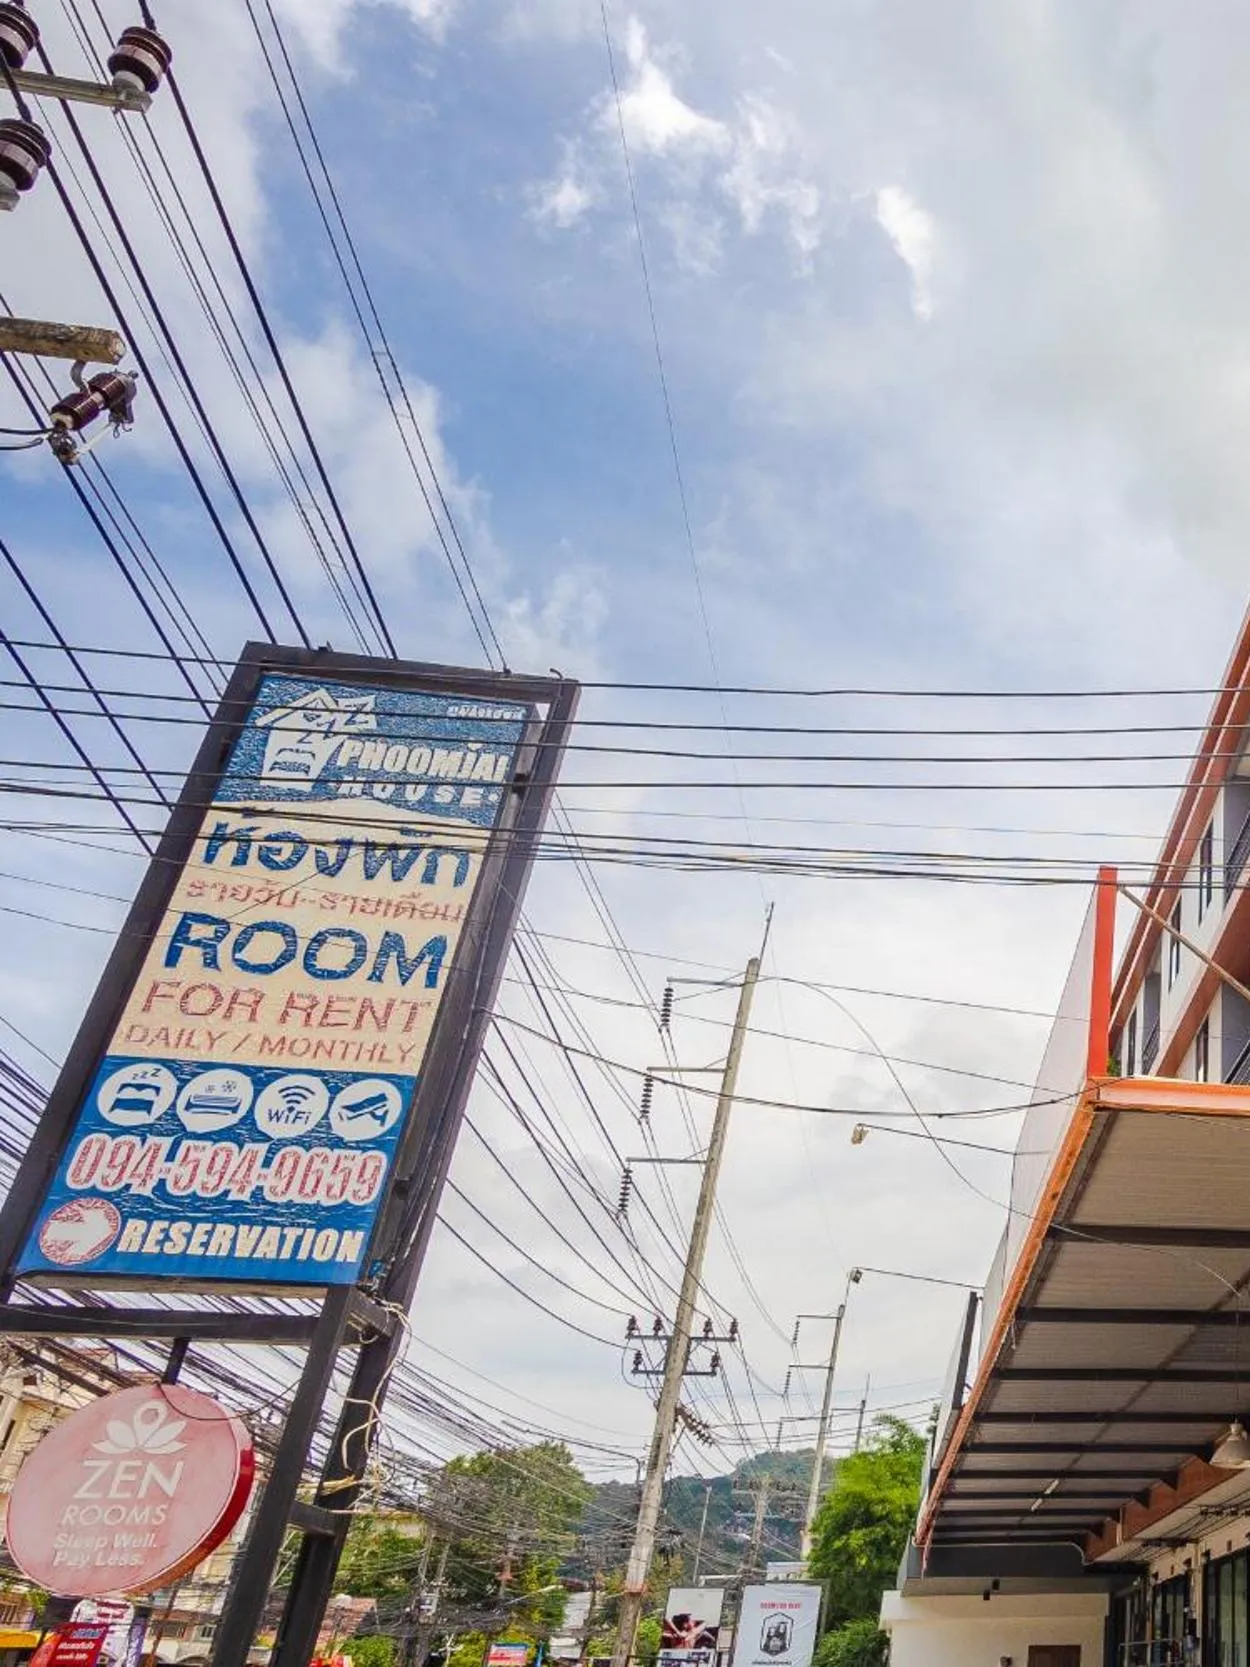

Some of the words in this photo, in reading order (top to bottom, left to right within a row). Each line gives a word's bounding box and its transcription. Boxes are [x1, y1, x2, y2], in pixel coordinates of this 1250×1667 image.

[337, 776, 483, 808] HOUSE
[163, 911, 448, 989] ROOM
[141, 979, 266, 1024] FOR
[279, 991, 432, 1033] RENT
[124, 1023, 228, 1051] DAILY
[258, 1034, 417, 1064] MONTHLY
[69, 1134, 386, 1204] 094-594-9659
[116, 1218, 366, 1263] RESERVATION
[72, 1459, 184, 1499] ZEN
[61, 1504, 169, 1526] ROOMS
[53, 1532, 108, 1551] Sleep
